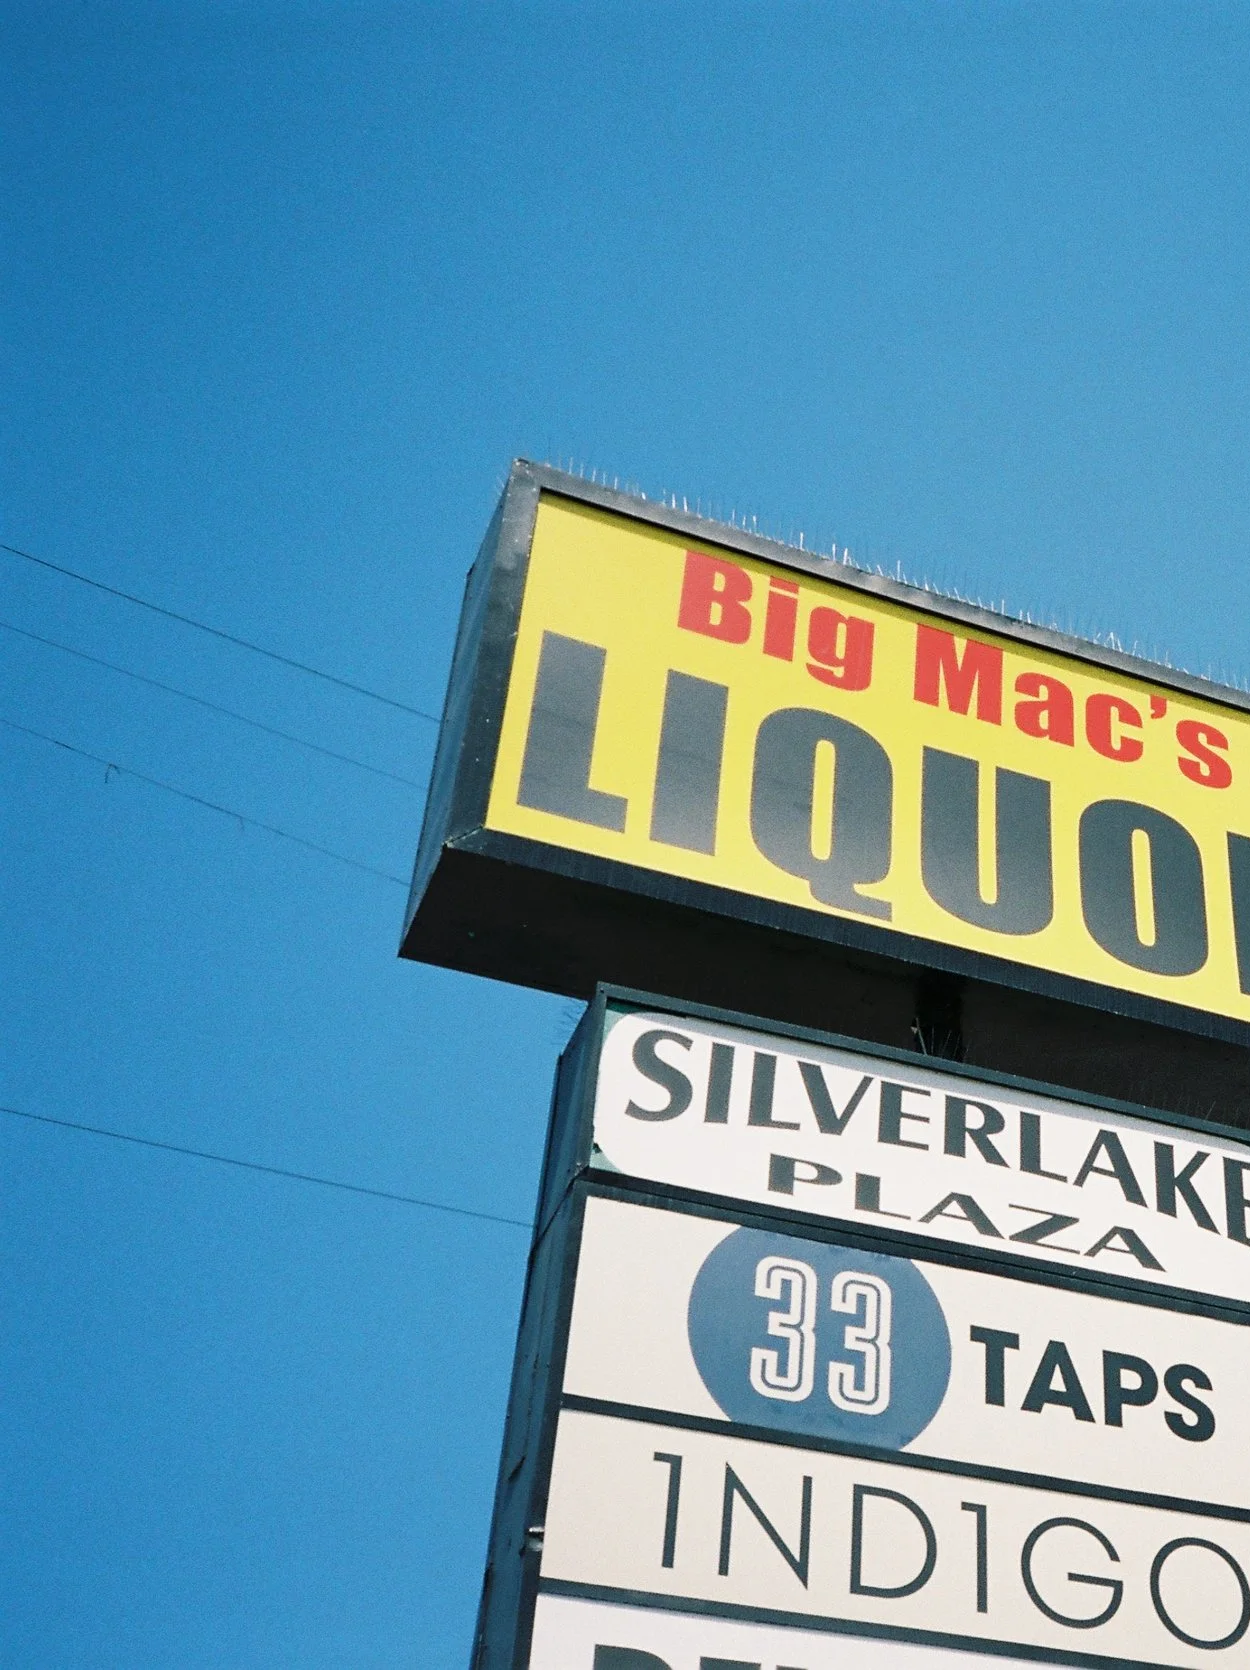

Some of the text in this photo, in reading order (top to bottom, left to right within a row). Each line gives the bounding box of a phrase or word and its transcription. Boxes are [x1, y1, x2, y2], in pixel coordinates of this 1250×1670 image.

[676, 549, 1233, 790] Big Mac's
[767, 1153, 1167, 1271] PLAZA
[750, 1255, 1216, 1443] 33 TAPS
